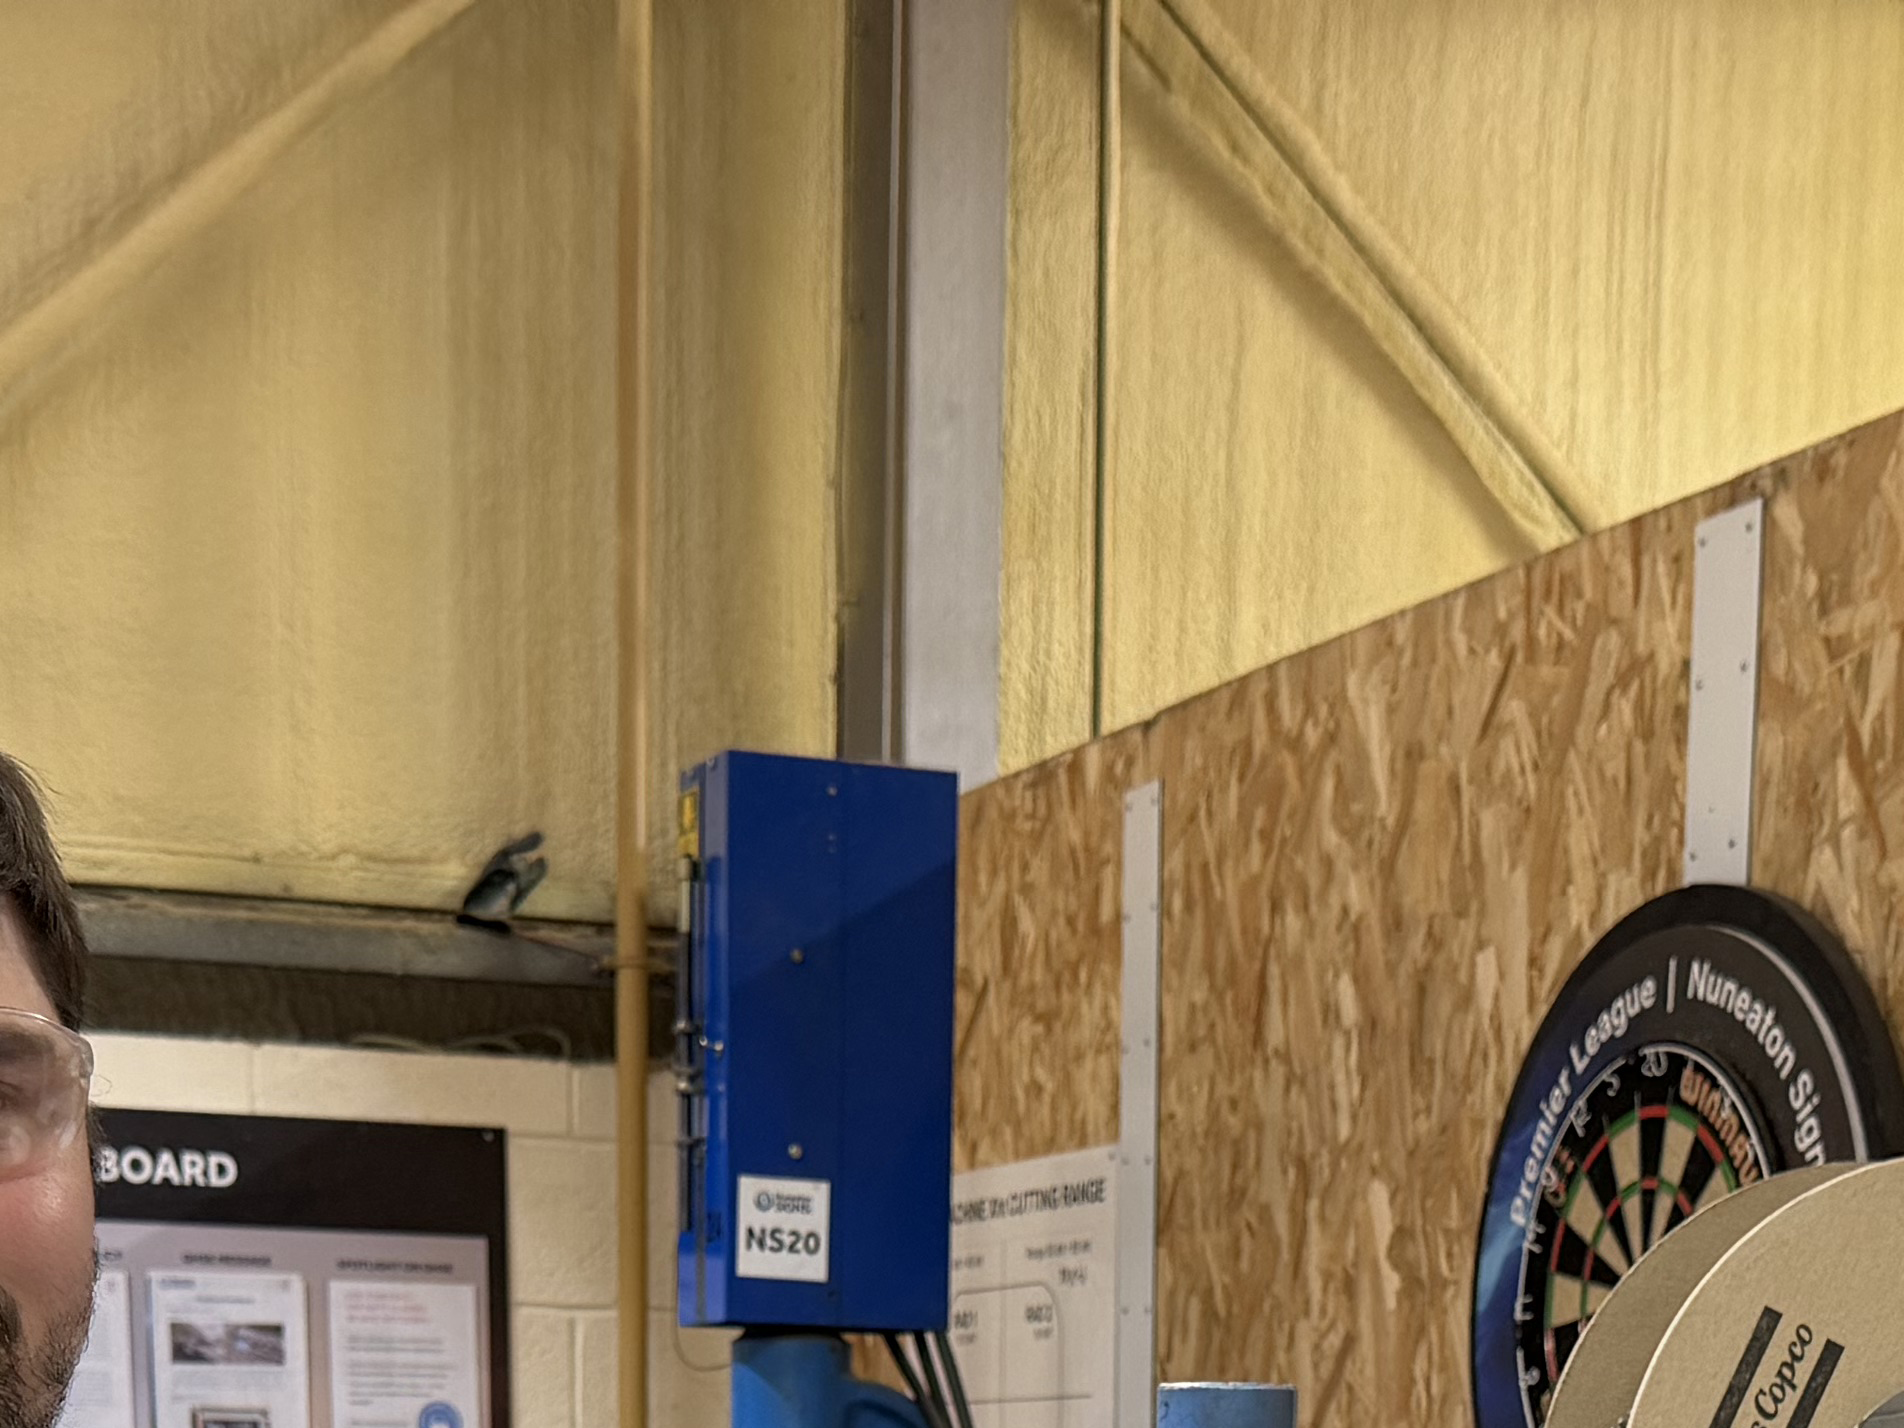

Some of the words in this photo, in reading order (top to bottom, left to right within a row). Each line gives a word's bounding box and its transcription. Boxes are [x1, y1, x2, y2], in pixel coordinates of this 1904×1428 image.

[1509, 1066, 1572, 1228] Premier
[1570, 975, 1657, 1076] League
[1687, 958, 1797, 1079] Nuneaton
[99, 1146, 239, 1189] BOARD
[746, 1226, 821, 1256] NS20
[1760, 1322, 1815, 1422] Copco
